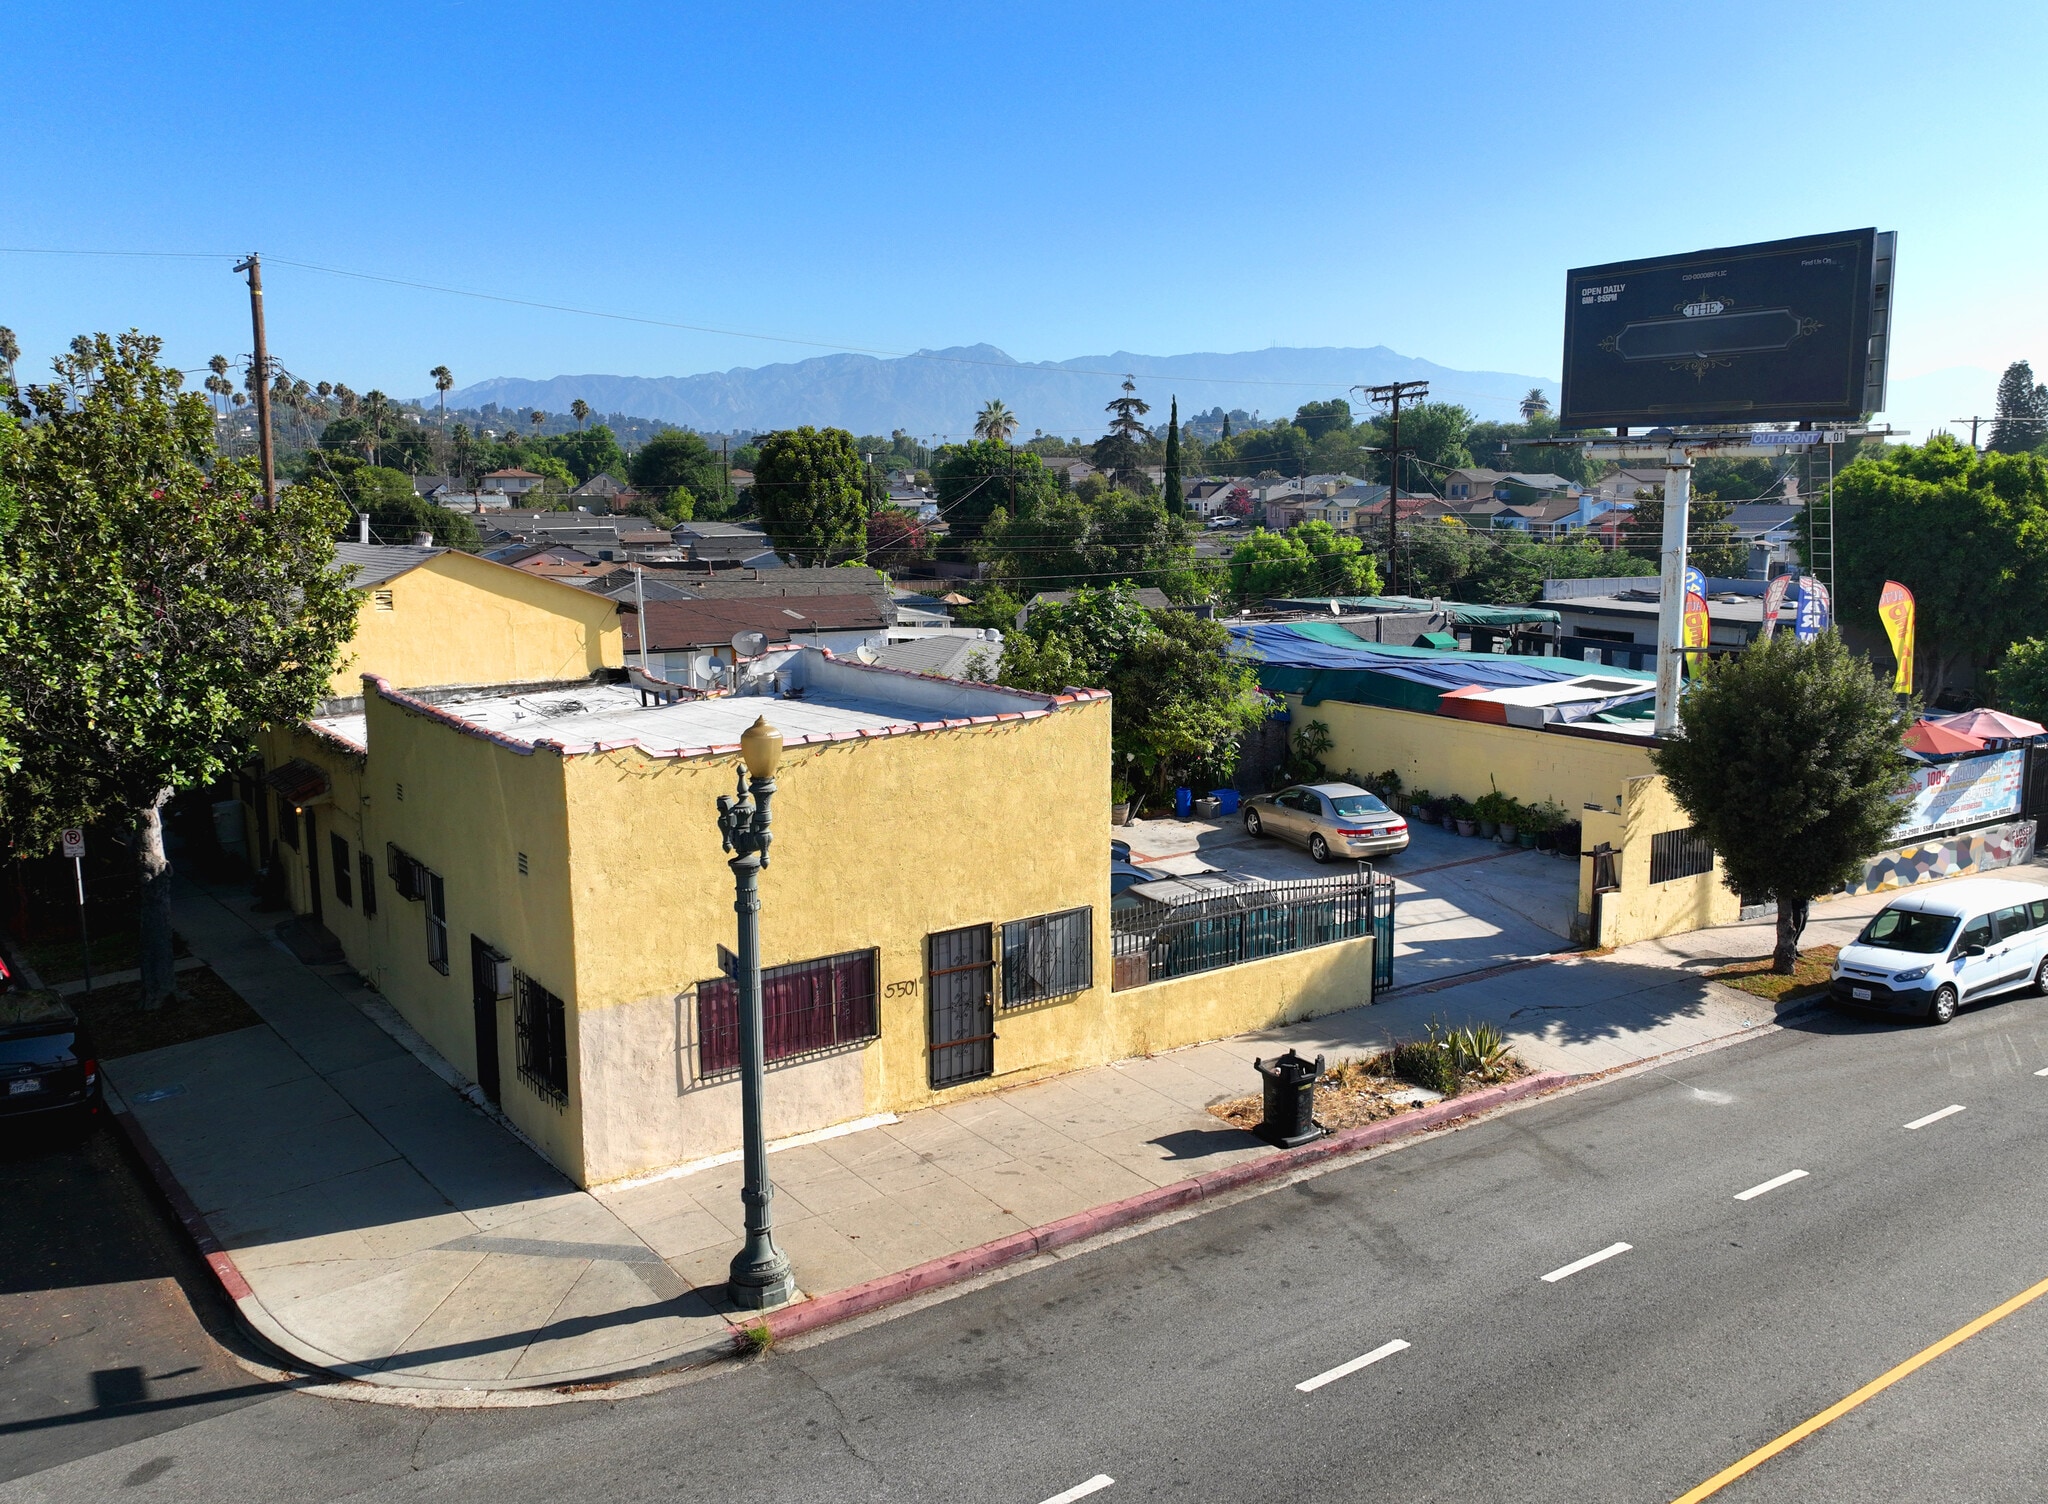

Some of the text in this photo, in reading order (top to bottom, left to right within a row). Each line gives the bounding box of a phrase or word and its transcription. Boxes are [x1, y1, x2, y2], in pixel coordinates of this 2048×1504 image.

[1581, 283, 1626, 296] OPEN DAILY
[1689, 303, 1718, 315] THE
[1753, 433, 1819, 444] OUTFRONT
[1952, 764, 1976, 783] HAND
[1977, 758, 2003, 779] WASH
[1927, 769, 1951, 787] 100%
[1934, 820, 1955, 830] Alhambra
[2012, 825, 2033, 839] CLOSED
[2014, 836, 2028, 848] WED
[884, 978, 918, 998] 5501
